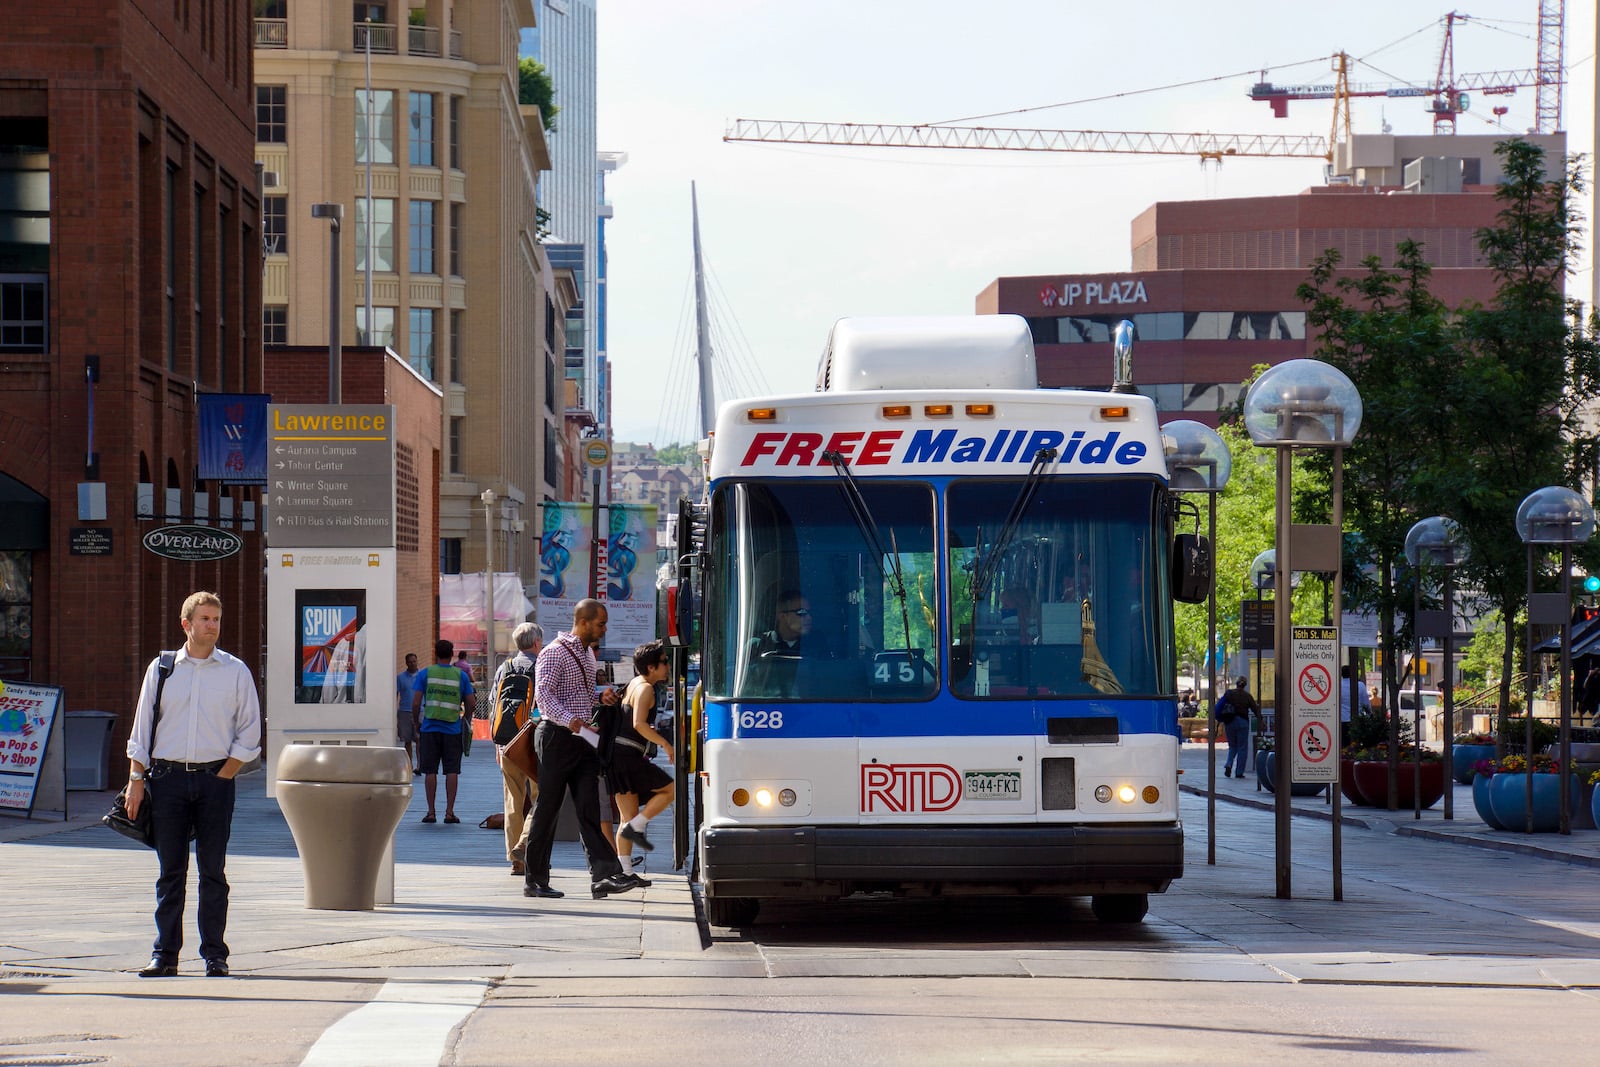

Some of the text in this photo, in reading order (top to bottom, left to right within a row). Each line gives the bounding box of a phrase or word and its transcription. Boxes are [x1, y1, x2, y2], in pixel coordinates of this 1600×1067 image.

[1058, 282, 1148, 306] JP PLAZA
[274, 409, 386, 430] Lawrence
[287, 444, 358, 456] Auraria Campus
[740, 429, 1147, 466] FREE MallRide
[288, 460, 344, 470] Tabor Center
[287, 480, 348, 492] Writer Square
[287, 496, 353, 507] Larimer Square
[287, 516, 389, 526] RTD Bus & Rail Stations
[148, 532, 234, 550] OVERLAND
[305, 608, 342, 636] SPUN
[1294, 629, 1308, 639] 16th
[1310, 630, 1319, 639] St.
[1322, 630, 1336, 639] Mall
[1299, 642, 1332, 650] Authorized
[1321, 652, 1335, 661] Only
[7, 687, 24, 695] Candy
[733, 710, 783, 729] 1628
[8, 740, 27, 752] Pop
[30, 741, 38, 751] &
[11, 753, 37, 766] Shop
[861, 764, 962, 812] RTD
